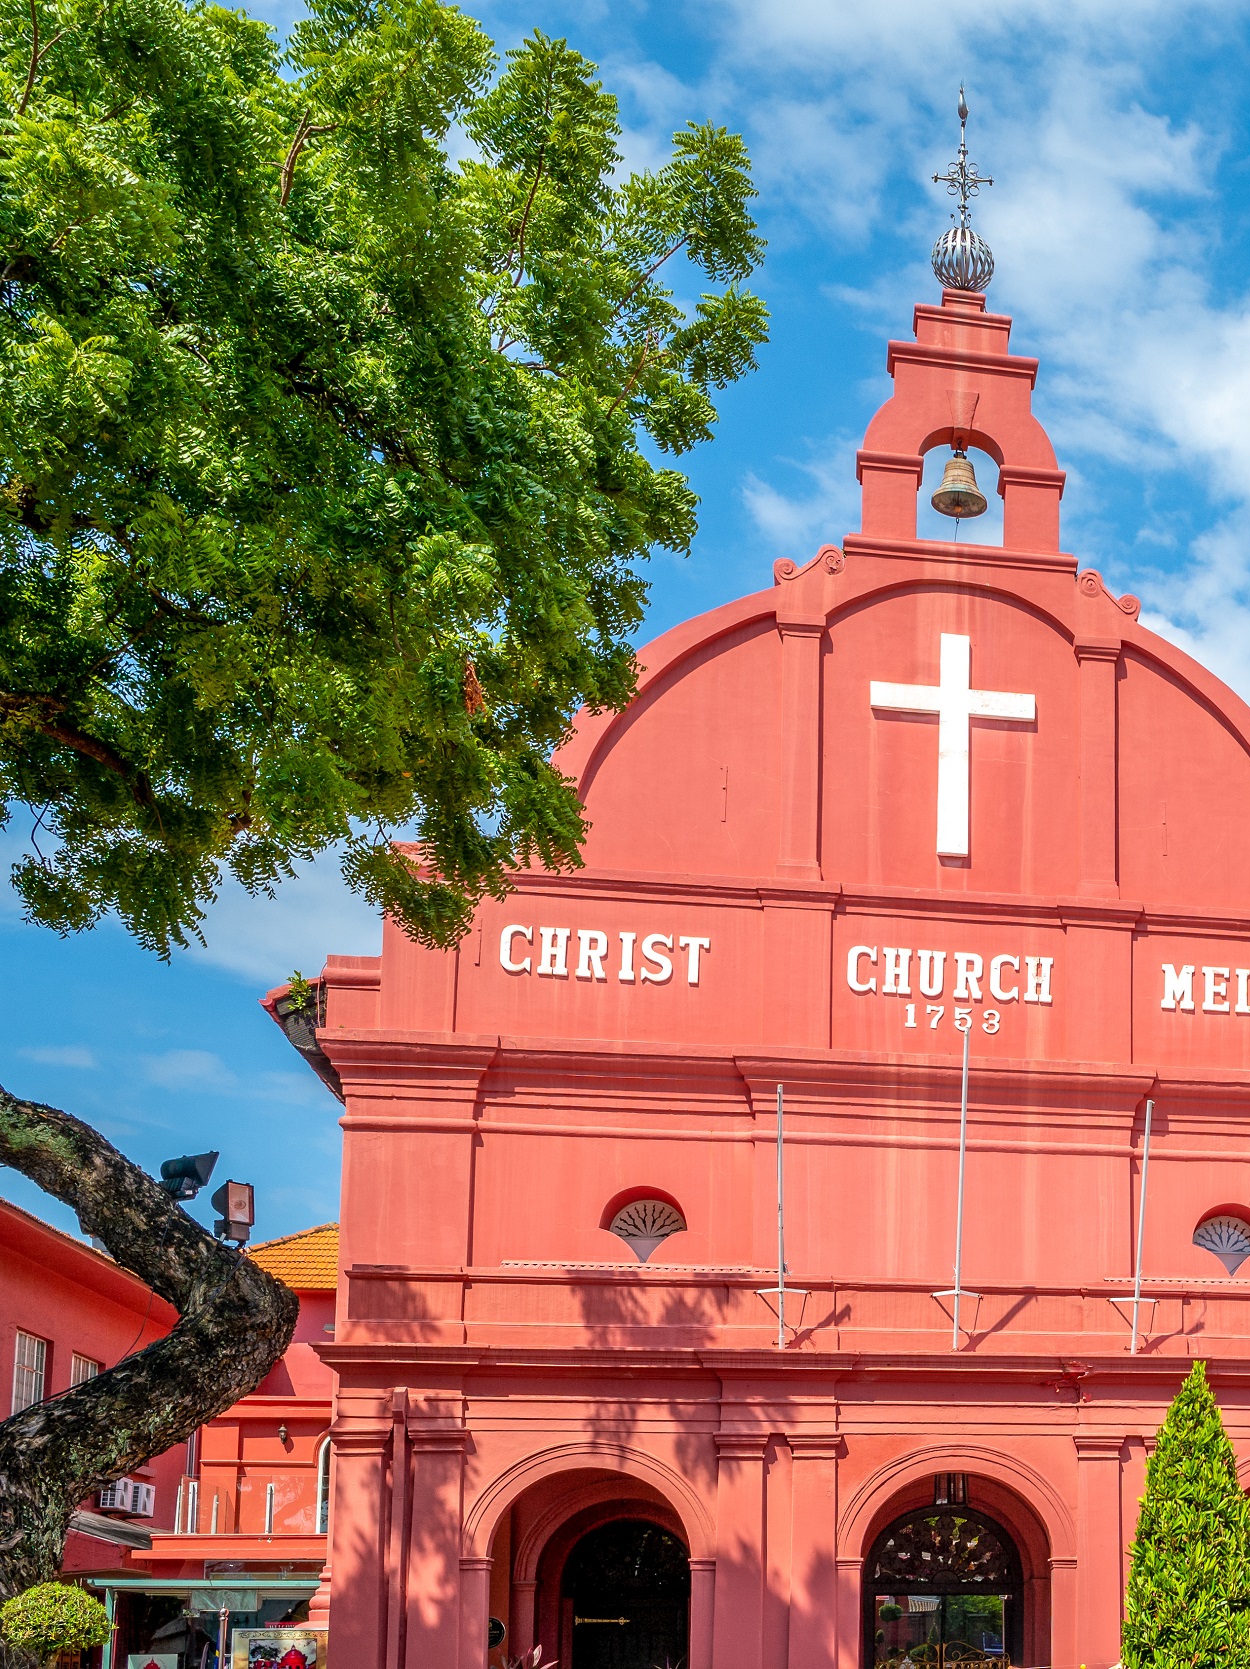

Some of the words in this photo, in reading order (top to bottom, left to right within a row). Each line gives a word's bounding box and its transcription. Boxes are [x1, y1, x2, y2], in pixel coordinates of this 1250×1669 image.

[499, 924, 711, 985] CHRIST
[846, 945, 1055, 1003] CHURCH
[904, 1003, 1001, 1034] 1753
